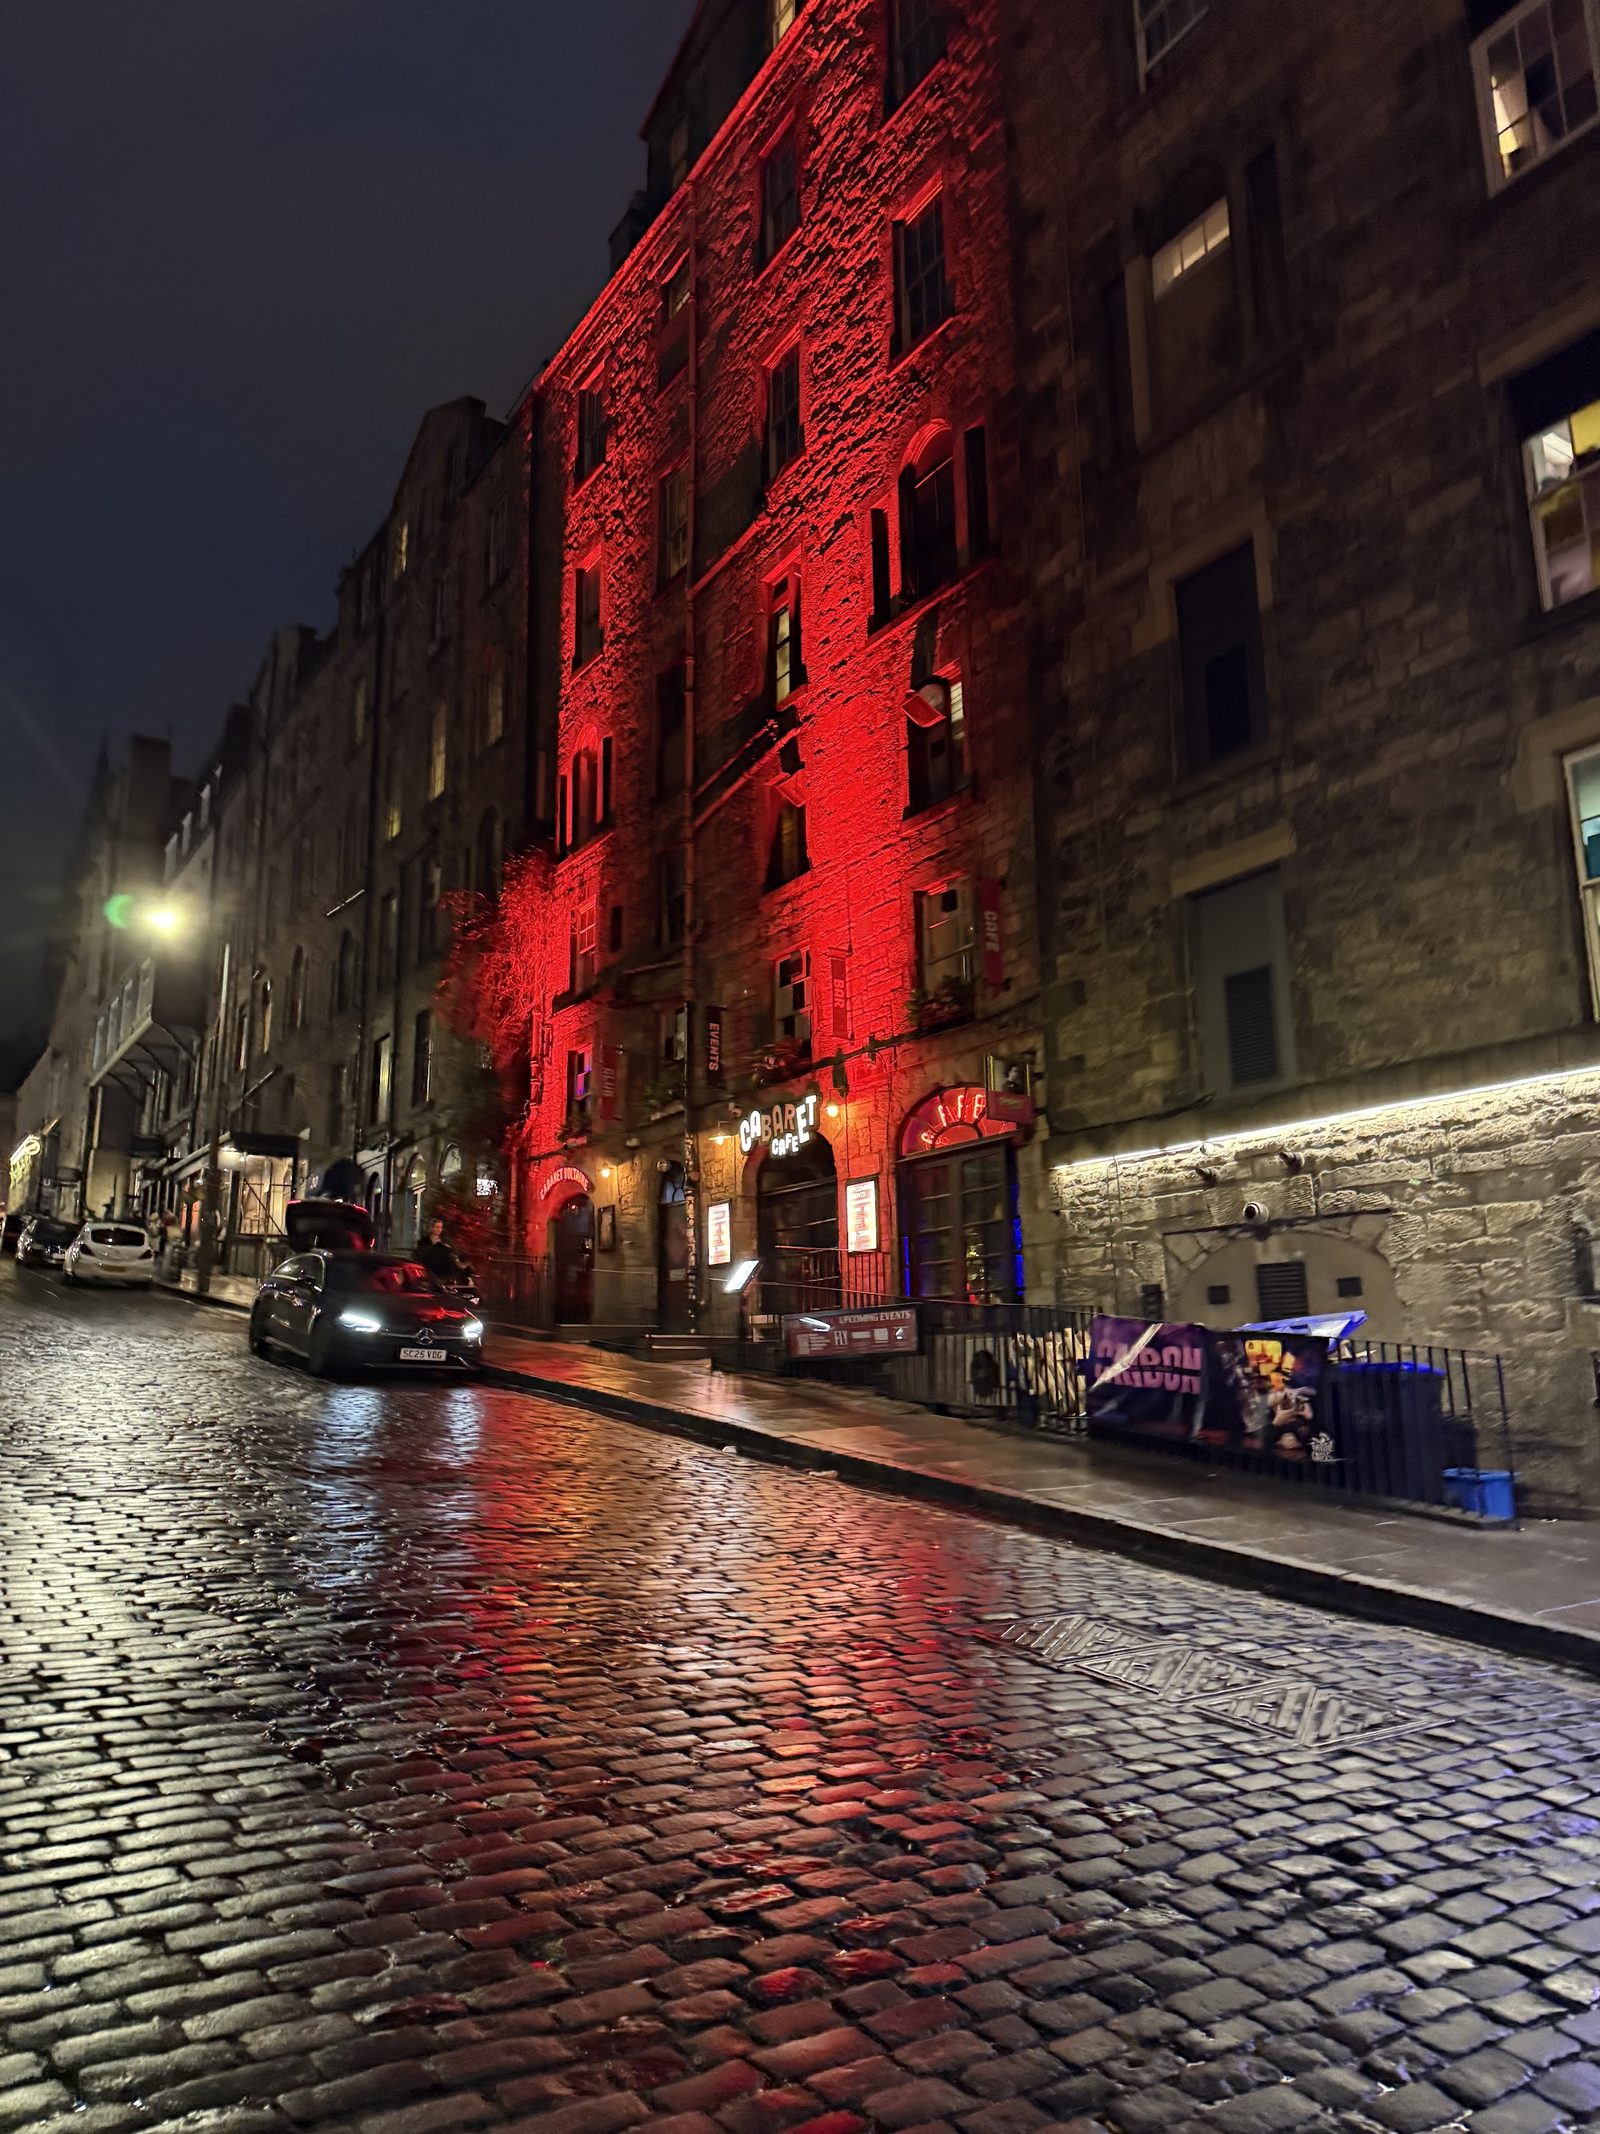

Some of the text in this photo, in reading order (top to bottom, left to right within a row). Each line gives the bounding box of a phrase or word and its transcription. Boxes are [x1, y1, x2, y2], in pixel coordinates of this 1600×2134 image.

[983, 910, 1000, 953] CAFE
[833, 978, 845, 1009] BAR
[708, 1022, 720, 1071] EVENTS
[740, 1094, 817, 1152] CABARET
[771, 1132, 799, 1156] CAFE
[540, 1167, 563, 1201] CABARET
[839, 1309, 911, 1324] UPCOMING EVENTS
